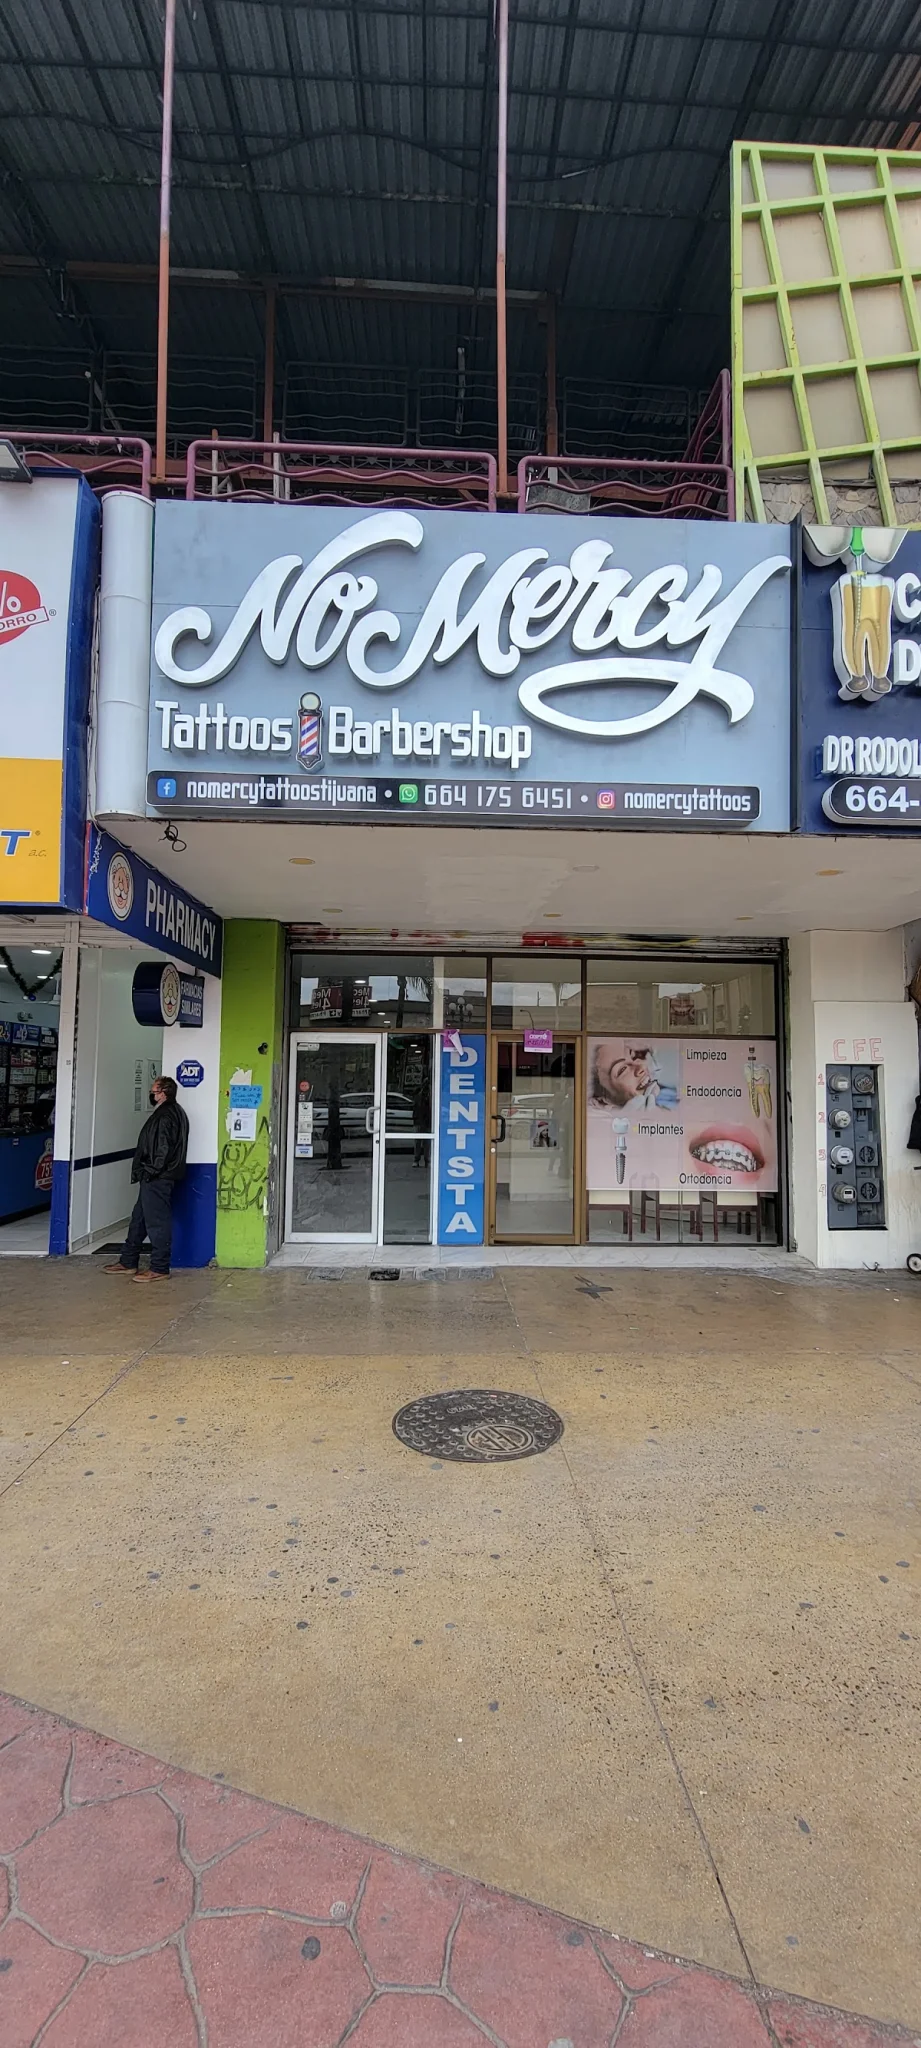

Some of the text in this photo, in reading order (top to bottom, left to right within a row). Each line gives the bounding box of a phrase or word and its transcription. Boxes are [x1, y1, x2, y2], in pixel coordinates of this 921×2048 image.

[155, 511, 792, 737] No Mercy
[155, 700, 532, 769] Tattoos Barbershop
[824, 735, 854, 775] DR
[187, 777, 751, 815] nomercytattoostijuana 664 175 6451 nomercytattoos
[145, 878, 216, 961] PHARMACY
[686, 1048, 727, 1063] Limpieza
[833, 1038, 884, 1062] CFE
[181, 1066, 200, 1077] ADT
[686, 1085, 742, 1098] Endodoncia
[638, 1122, 684, 1136] Implantes
[818, 1112, 826, 1124] 2
[445, 1046, 478, 1233] DENTSTA
[679, 1172, 732, 1185] Ortodoncia
